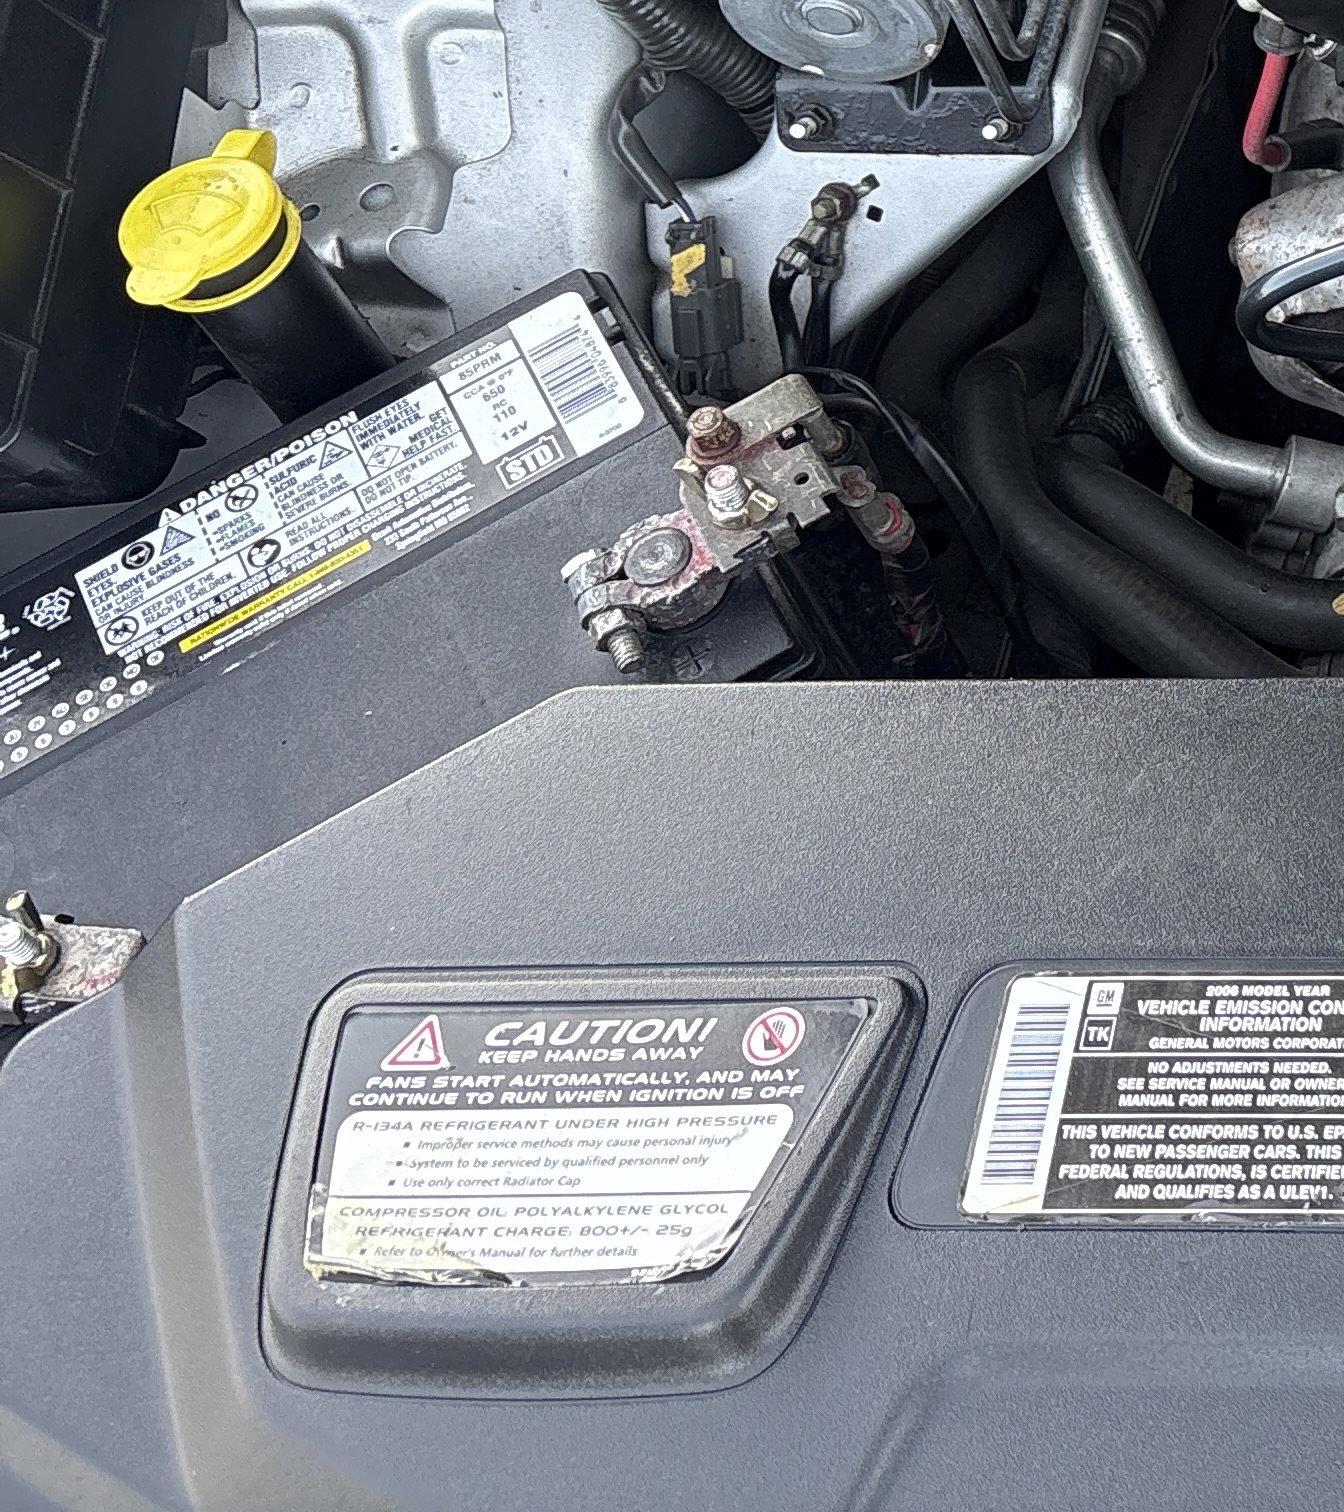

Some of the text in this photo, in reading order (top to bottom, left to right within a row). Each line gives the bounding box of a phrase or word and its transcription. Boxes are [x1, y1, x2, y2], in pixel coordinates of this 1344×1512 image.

[456, 351, 502, 381] 85PRM
[480, 383, 507, 403] 650
[350, 397, 410, 435] FLUSH EYES
[354, 400, 423, 442] IMMEDIATELY
[427, 405, 449, 423] GET
[491, 404, 517, 424] 110
[407, 414, 453, 444] MEDICAL
[499, 419, 531, 442] 12V
[358, 430, 386, 451] WITH
[400, 438, 428, 458] HELP
[177, 409, 359, 514] DANGER/POISON
[267, 453, 318, 486] SULFURIC
[503, 442, 556, 483] STD
[271, 475, 298, 495] ACID
[90, 551, 182, 607] EXPLOSIVE GASES
[1096, 990, 1116, 1003] GM
[1241, 985, 1292, 997] MODEL
[1293, 985, 1331, 997] YEAR
[1137, 1000, 1212, 1015] VEHICLE
[1215, 1000, 1305, 1015] EMISSION
[484, 1017, 719, 1046] CAUTION!
[1199, 1017, 1323, 1032] INFORMATION
[1086, 1026, 1110, 1042] TK
[1149, 1038, 1209, 1050] GENERAL
[1212, 1038, 1270, 1050] MOTORS
[478, 1046, 704, 1064] KEEP HANDS AWAY
[1148, 1062, 1332, 1074] NO ADJUSTMENTS NEEDED.
[366, 1068, 800, 1089] FANS START AUTOMATICALLY, AND MAY
[1117, 1078, 1146, 1090] SEE
[1149, 1078, 1207, 1090] SERVICE
[1209, 1078, 1266, 1091] MANUAL
[1269, 1078, 1291, 1090] OR
[348, 1085, 805, 1106] CONTINUE TO RUN WHEN IGNITION IS OFF
[1118, 1094, 1176, 1107] MANUAL
[1179, 1094, 1208, 1107] FOR
[1210, 1094, 1253, 1107] MORE
[352, 1114, 778, 1131] R-134A REFRIGERANT UNDER HIGH PRESSURE
[1061, 1125, 1098, 1139] THIS
[1101, 1125, 1165, 1139] VEHICLE
[1168, 1125, 1259, 1140] CONFORMS
[1262, 1125, 1284, 1139] TO
[1287, 1125, 1319, 1140] U.S.
[417, 1135, 733, 1152] Improper service methods may cause personal injury
[1089, 1144, 1111, 1159] TO
[1113, 1144, 1152, 1159] NEW
[1155, 1144, 1251, 1160] PASSENGER
[1253, 1144, 1301, 1160] CARS.
[1306, 1145, 1342, 1160] THIS
[1059, 1164, 1130, 1179] FEDERAL
[1133, 1165, 1246, 1181] REGULATIONS,
[1250, 1165, 1268, 1179] IS
[403, 1176, 581, 1189] Use only correct Radiator Cap
[1114, 1185, 1150, 1199] AND
[1153, 1185, 1235, 1200] QUALIFIES
[1238, 1185, 1261, 1199] AS
[1263, 1185, 1276, 1199] A
[339, 1206, 471, 1218] COMPRESSOR
[514, 1205, 653, 1217] POLYALKYLENE
[659, 1204, 729, 1215] GLYCOL
[354, 1226, 488, 1238] REFRIGERANT
[655, 1225, 693, 1237] 25g
